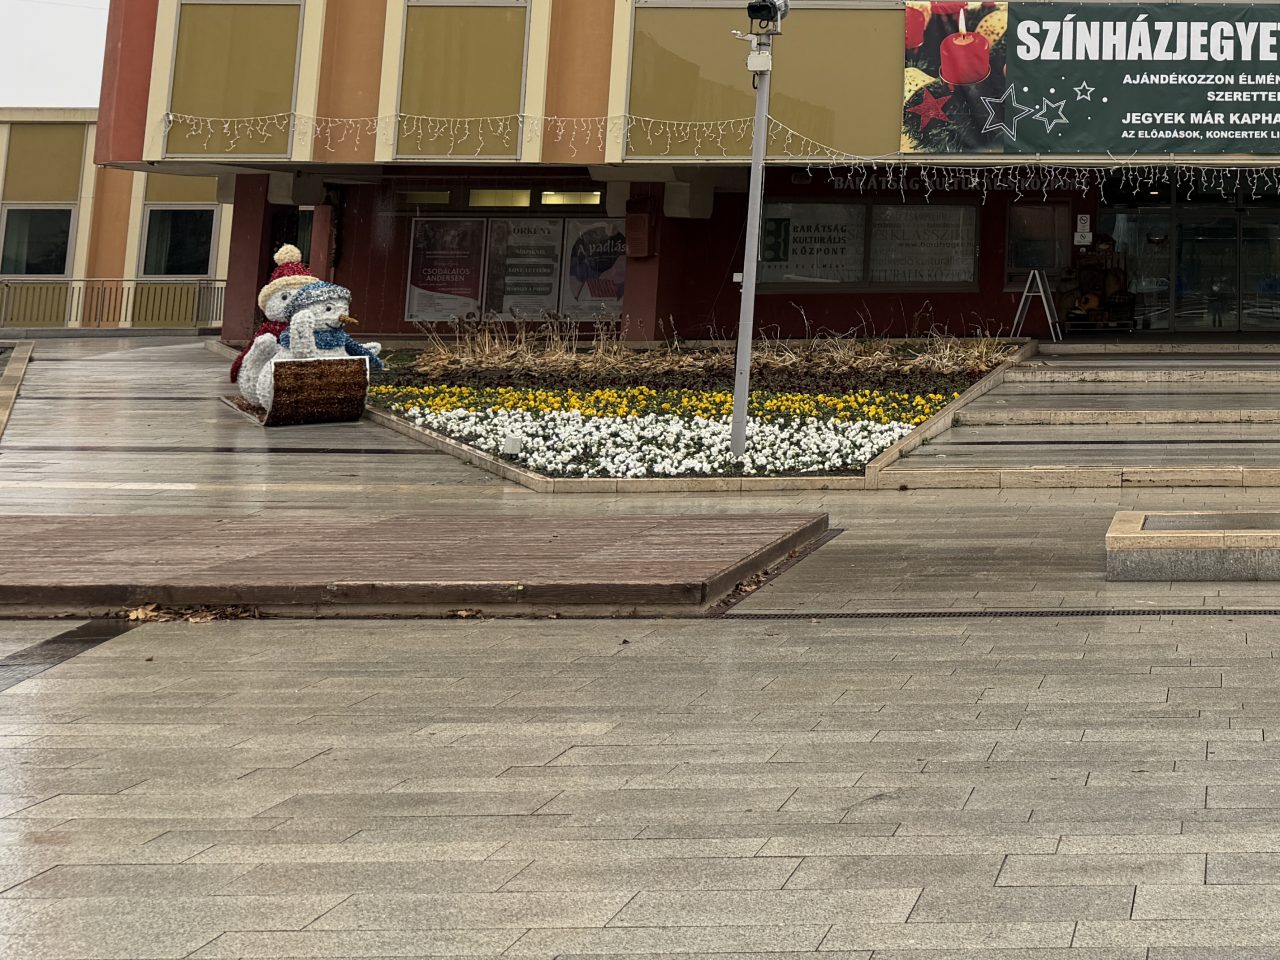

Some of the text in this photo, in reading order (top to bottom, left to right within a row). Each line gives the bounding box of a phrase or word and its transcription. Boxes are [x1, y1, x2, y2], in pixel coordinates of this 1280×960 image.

[1122, 72, 1235, 85] AJÁNDÉKOZZON
[1122, 112, 1186, 124] JEGYEK
[1190, 110, 1225, 124] MÁR
[1121, 130, 1135, 139] AZ
[1206, 130, 1268, 139] KONCERTEK
[792, 223, 847, 233] BARÁTSÁG
[792, 235, 847, 245] KULTURÁLIS
[791, 246, 847, 255] KÖZPONT
